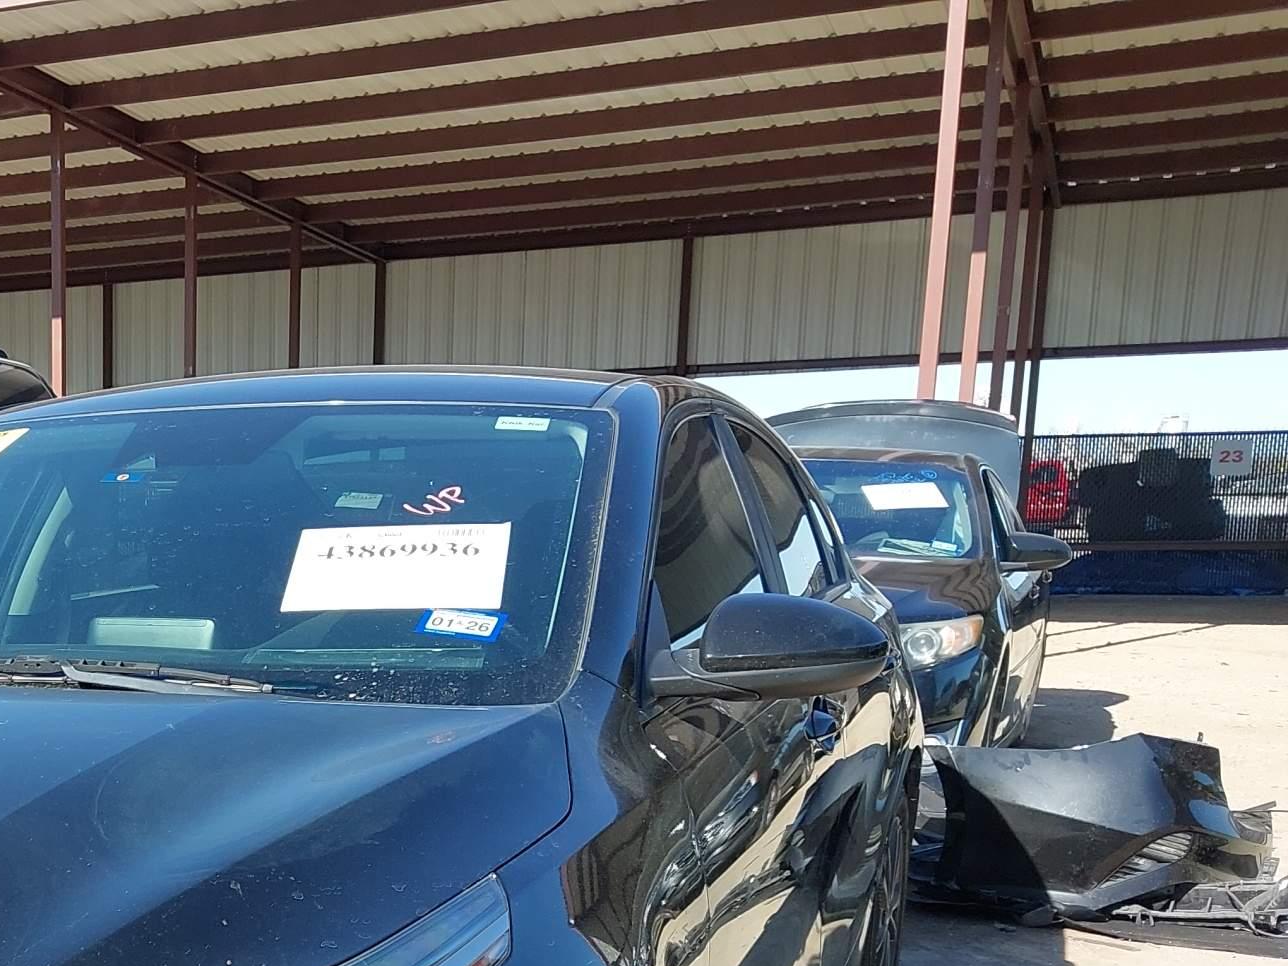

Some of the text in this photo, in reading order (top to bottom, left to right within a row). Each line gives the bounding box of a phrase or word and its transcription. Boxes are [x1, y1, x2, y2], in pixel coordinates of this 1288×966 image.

[1218, 450, 1244, 464] 23
[402, 485, 465, 516] WP
[317, 542, 481, 560] 43869936
